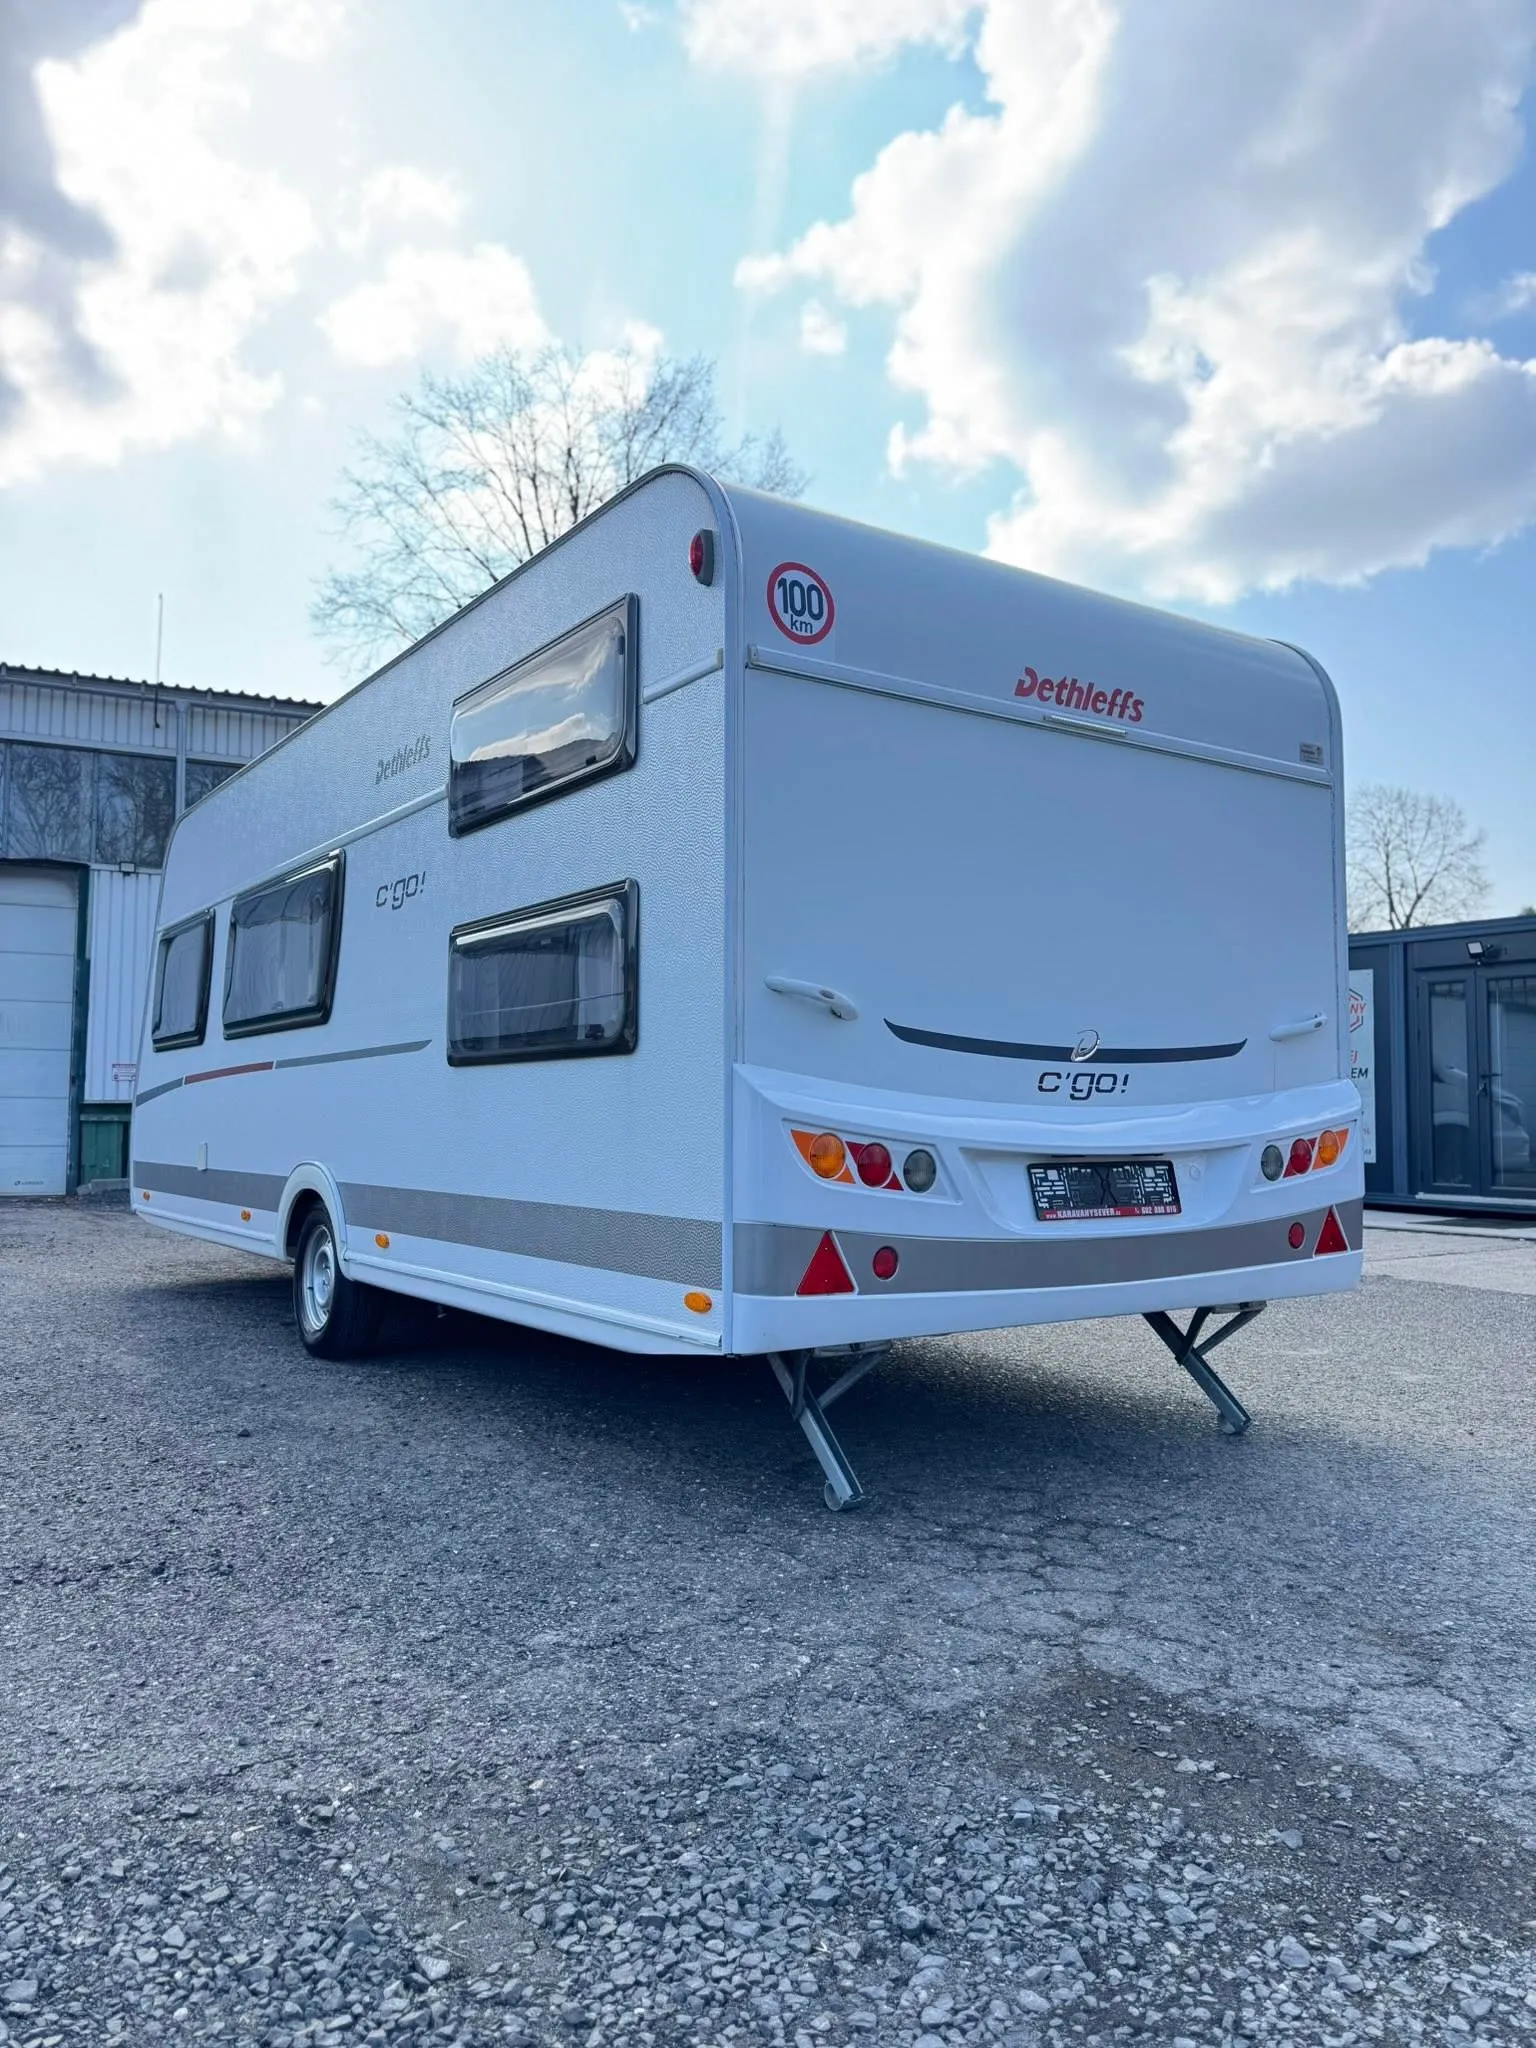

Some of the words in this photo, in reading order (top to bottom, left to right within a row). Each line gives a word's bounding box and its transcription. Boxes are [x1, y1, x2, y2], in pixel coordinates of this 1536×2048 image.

[778, 577, 824, 621] 100
[790, 615, 813, 634] km
[1014, 666, 1144, 722] Dethleffs
[375, 735, 431, 785] Dethleffs
